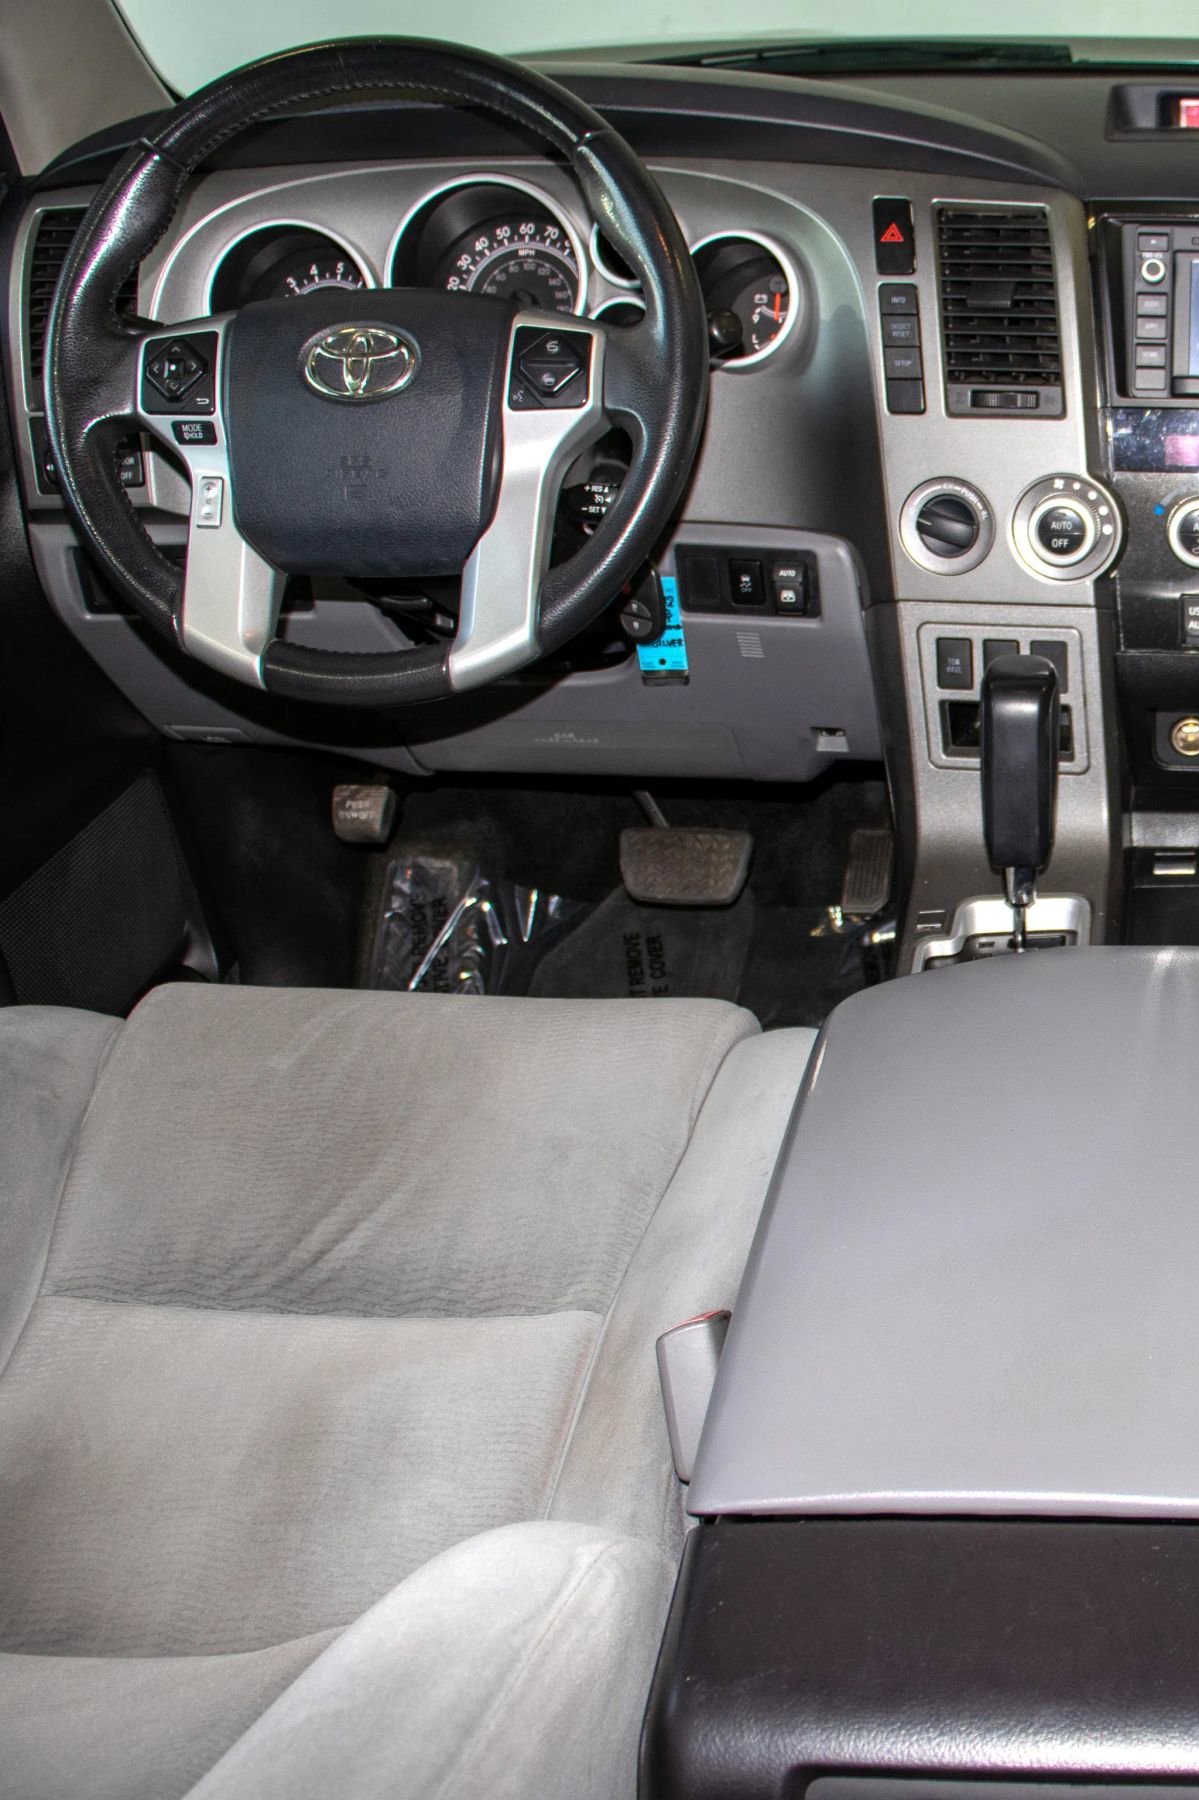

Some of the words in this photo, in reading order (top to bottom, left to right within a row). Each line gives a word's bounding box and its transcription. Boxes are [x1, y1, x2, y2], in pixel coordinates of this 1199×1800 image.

[496, 226, 511, 240] 50
[520, 223, 535, 235] 60
[544, 225, 559, 239] 70
[475, 237, 489, 252] 40
[518, 249, 535, 257] MPH
[336, 262, 344, 273] 5
[457, 254, 471, 270] 30
[310, 264, 318, 275] 4
[286, 277, 296, 289] 3
[447, 277, 460, 290] 20
[890, 296, 906, 304] INFO
[182, 424, 202, 432] MODE
[1050, 521, 1073, 530] AUTO
[1051, 538, 1069, 548] OFF
[779, 569, 796, 577] AUTO
[622, 931, 645, 987] REMOVE
[645, 935, 667, 979] COVER
